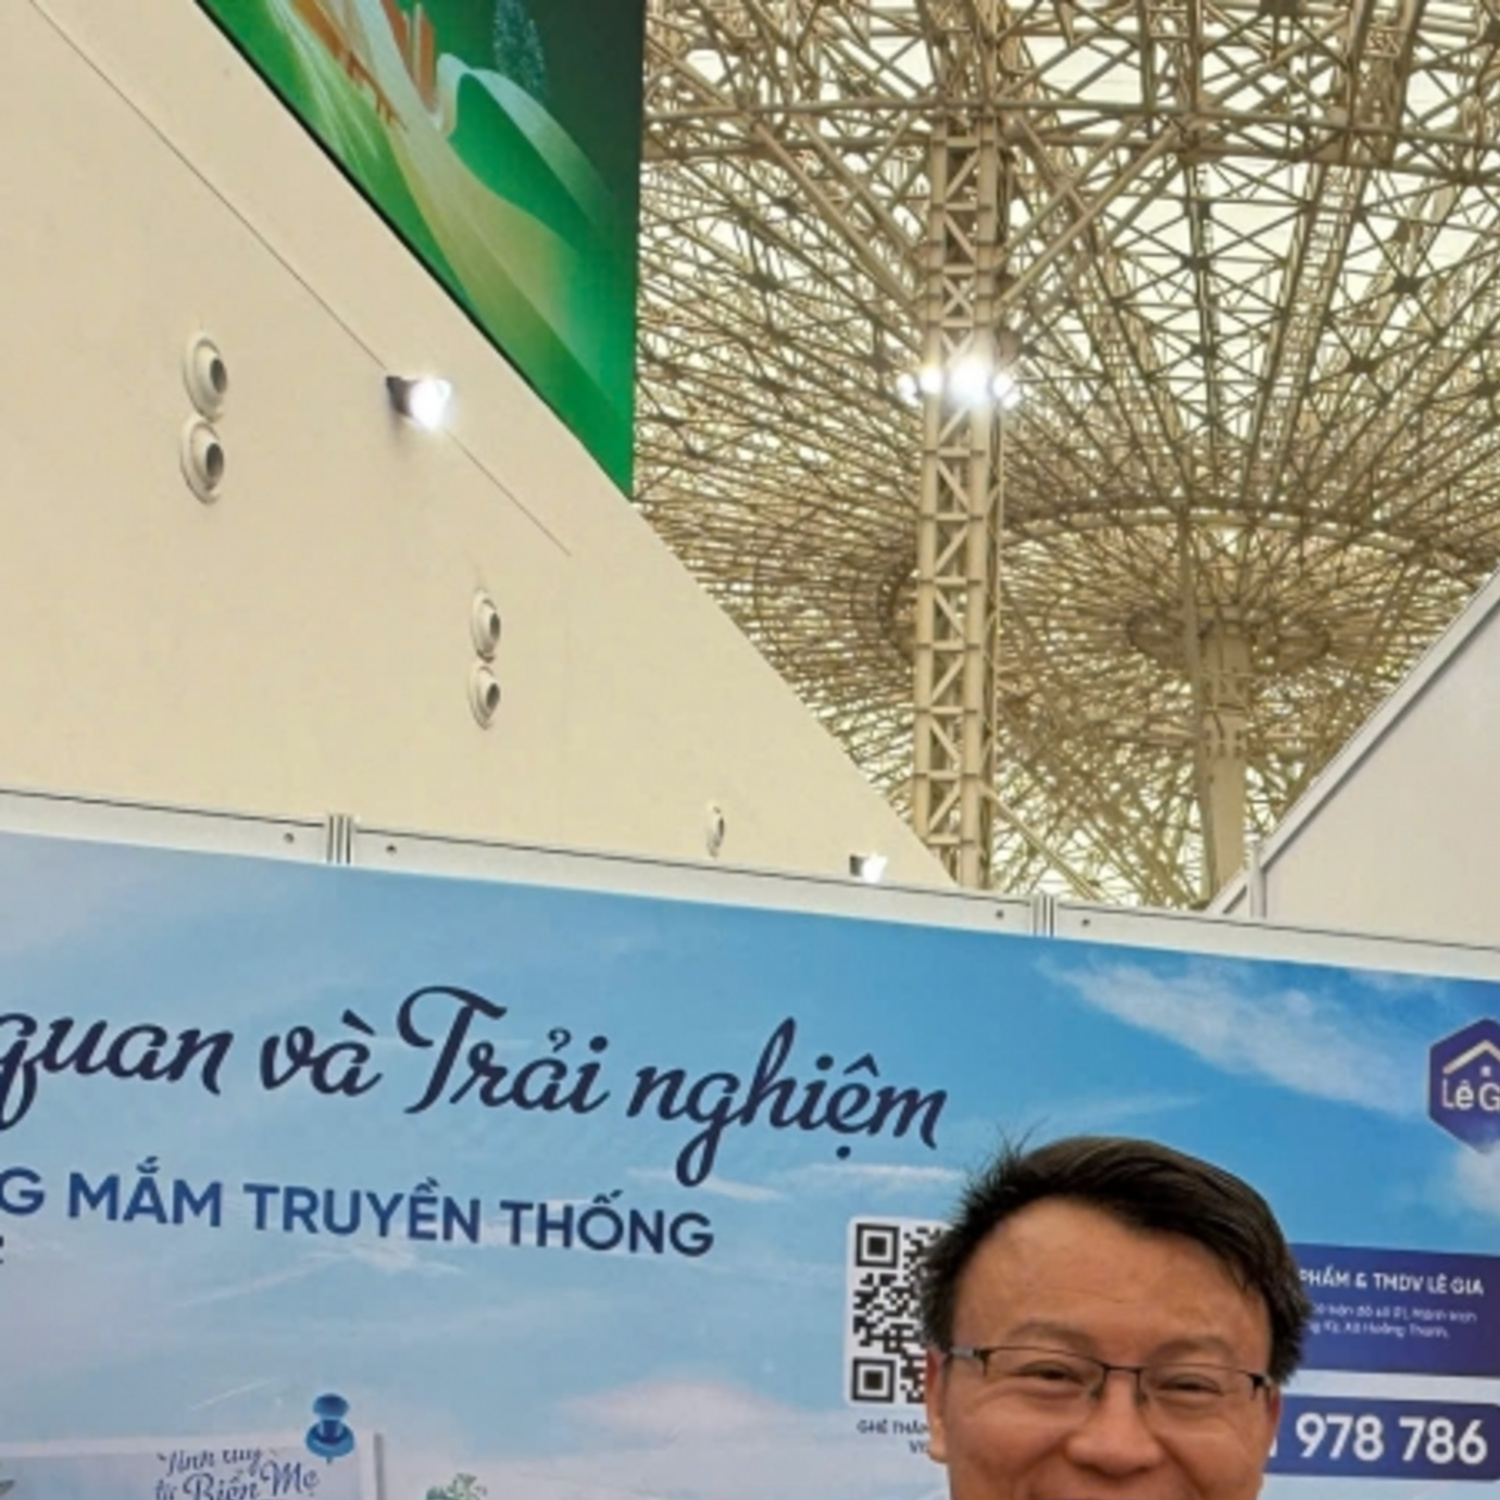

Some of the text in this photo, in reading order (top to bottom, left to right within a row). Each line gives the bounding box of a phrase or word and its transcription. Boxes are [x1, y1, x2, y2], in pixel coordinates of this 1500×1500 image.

[260, 1008, 383, 1096] và
[397, 985, 611, 1114] Trải
[626, 1016, 948, 1187] nghiệm
[68, 1155, 222, 1228] MẮM
[243, 1176, 481, 1243] TRUYỀN
[499, 1189, 715, 1257] THỐNG
[1295, 1412, 1488, 1465] 978 786
